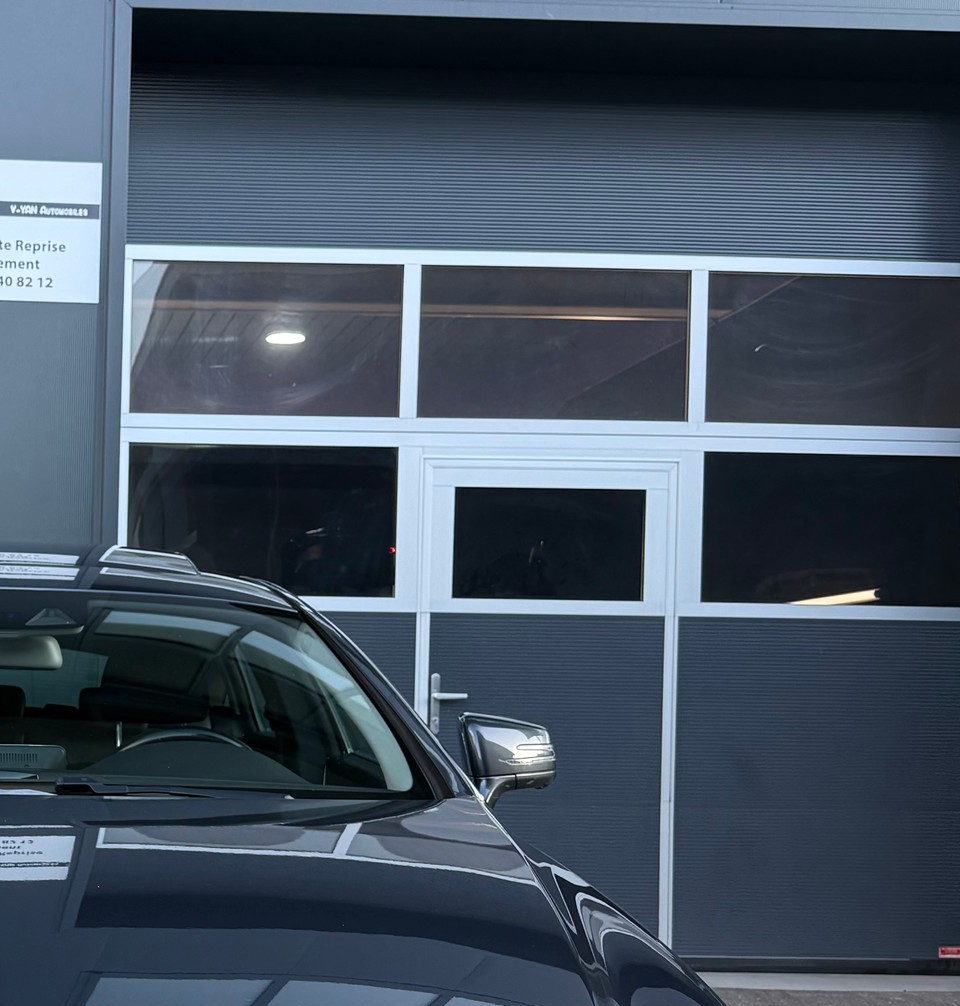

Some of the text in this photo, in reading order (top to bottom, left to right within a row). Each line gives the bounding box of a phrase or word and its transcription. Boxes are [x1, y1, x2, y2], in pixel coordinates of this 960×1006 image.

[10, 204, 38, 215] V-YAN
[16, 240, 66, 254] Reprise
[16, 276, 33, 288] 82
[38, 277, 53, 288] 12
